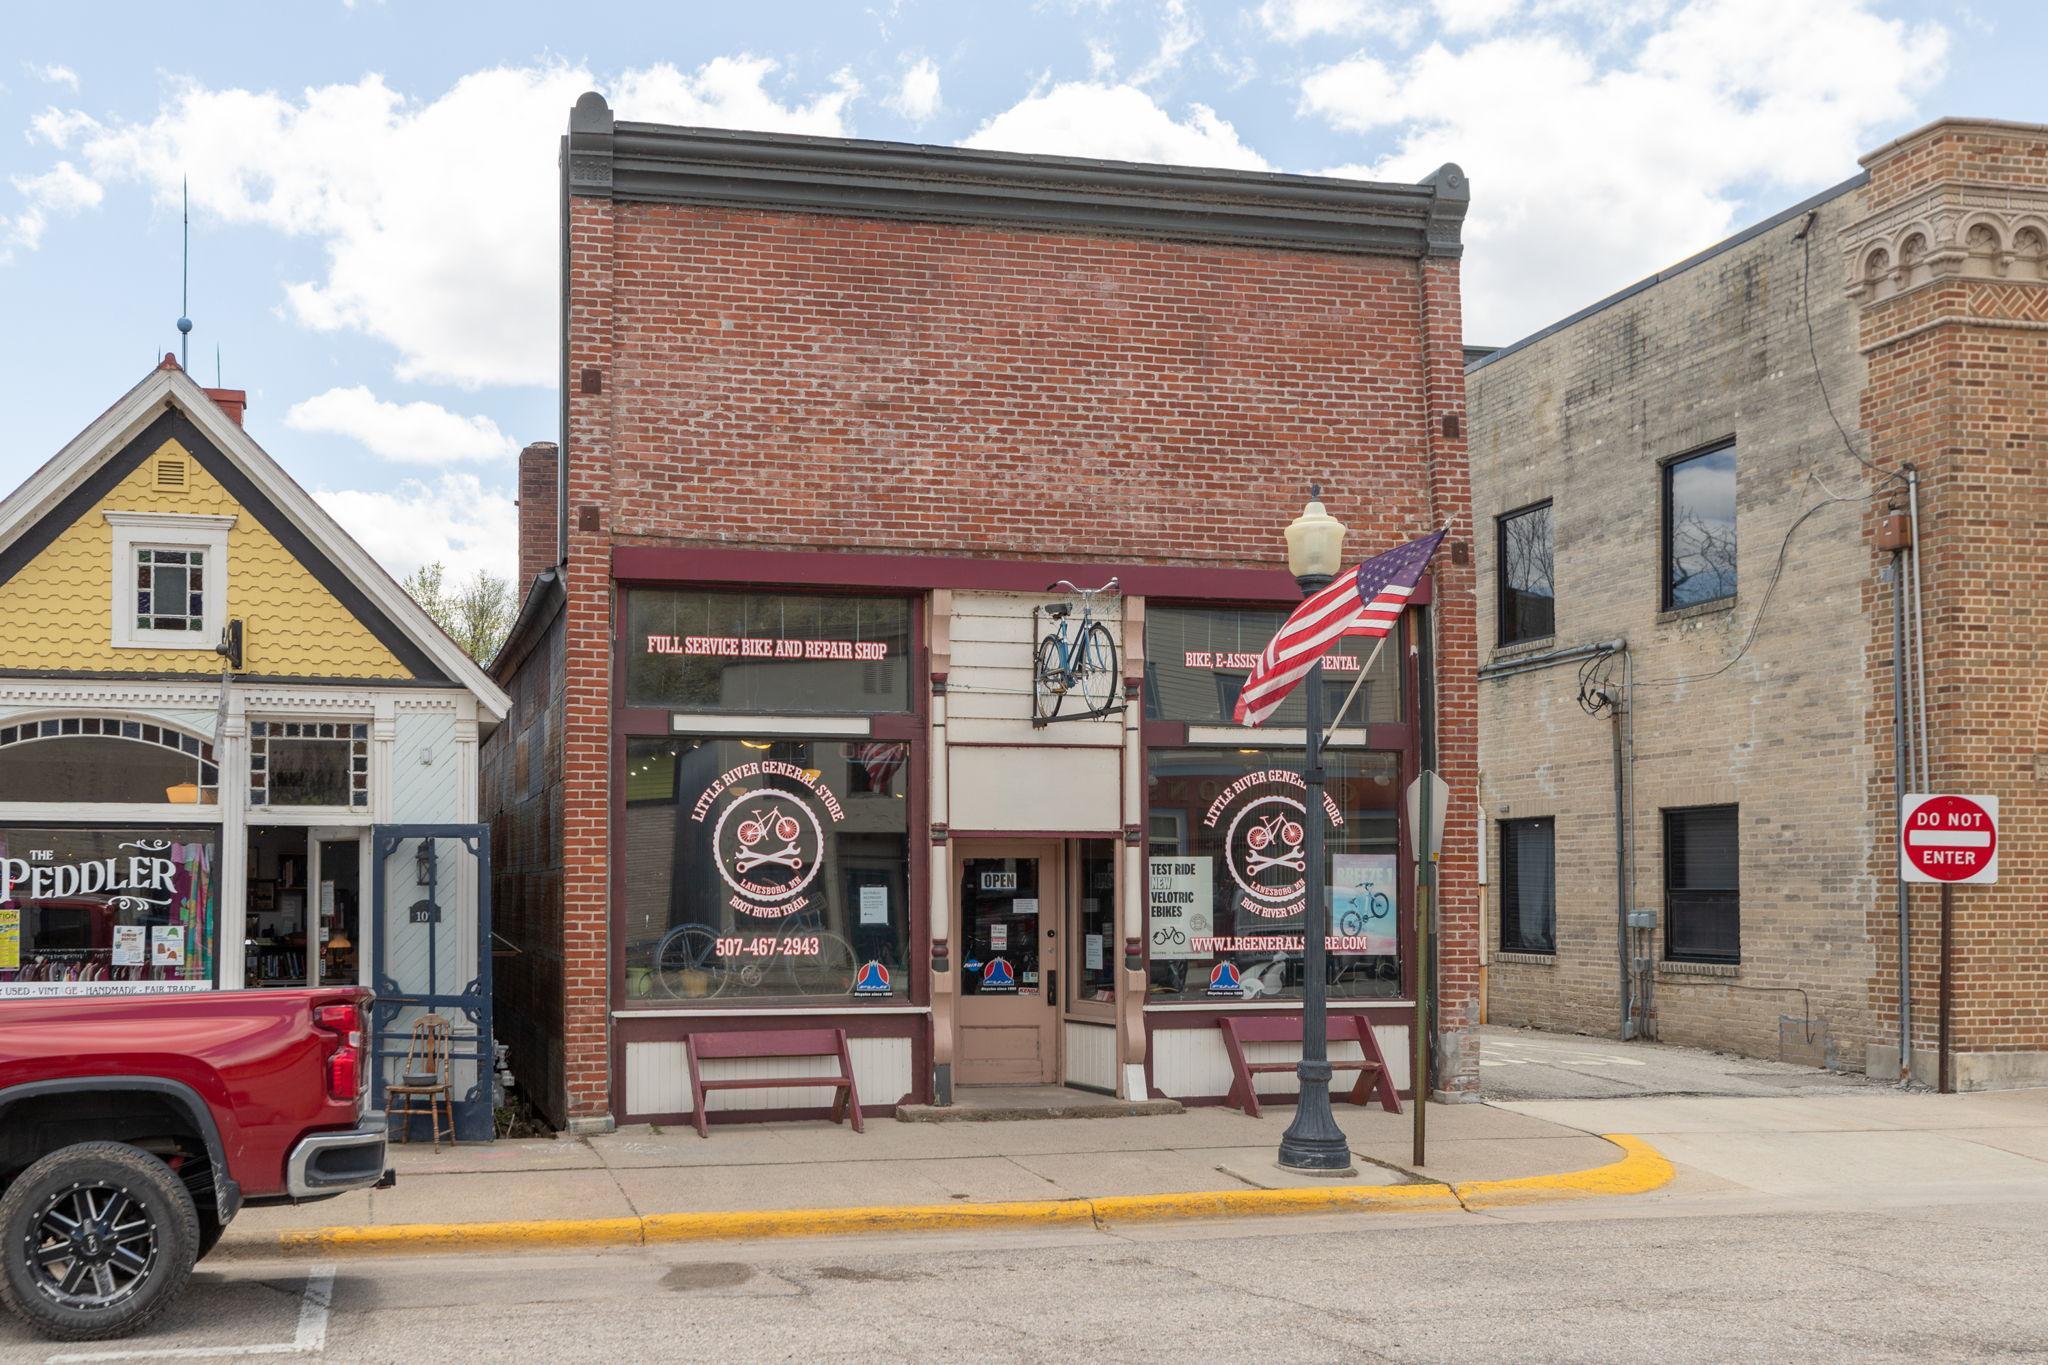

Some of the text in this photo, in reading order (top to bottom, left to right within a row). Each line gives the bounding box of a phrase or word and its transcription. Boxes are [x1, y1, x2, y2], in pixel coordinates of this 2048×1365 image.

[647, 635, 887, 660] FULL SERVICE BIKE AND REPAIR SHOP
[1185, 652, 1213, 669] BIKE,
[691, 760, 845, 823] LITTLE RIVER GENERAL STORE
[1203, 787, 1236, 828] LITTLE
[1232, 771, 1267, 794] RIVER
[1268, 769, 1307, 790] GENER
[1917, 812, 1983, 827] DO NOT
[29, 849, 54, 861] THE
[1923, 850, 1976, 865] ENTER
[1151, 863, 1196, 875] TEST RIDE
[0, 856, 178, 904] PEDDLER
[740, 876, 802, 895] LANESBORO, MN
[984, 873, 1015, 888] OPEN
[1151, 877, 1172, 890] NEW
[1250, 878, 1306, 897] LANESBORO, MN
[1151, 891, 1194, 904] VELOTRIC
[729, 895, 809, 918] ROOT RIVER TRAIL
[1151, 905, 1183, 918] EBIKES
[1240, 896, 1306, 919] ROOT RIVER TRA
[715, 937, 819, 956] 507-467-2943
[5, 987, 30, 996] USED
[145, 985, 165, 993] FAIR
